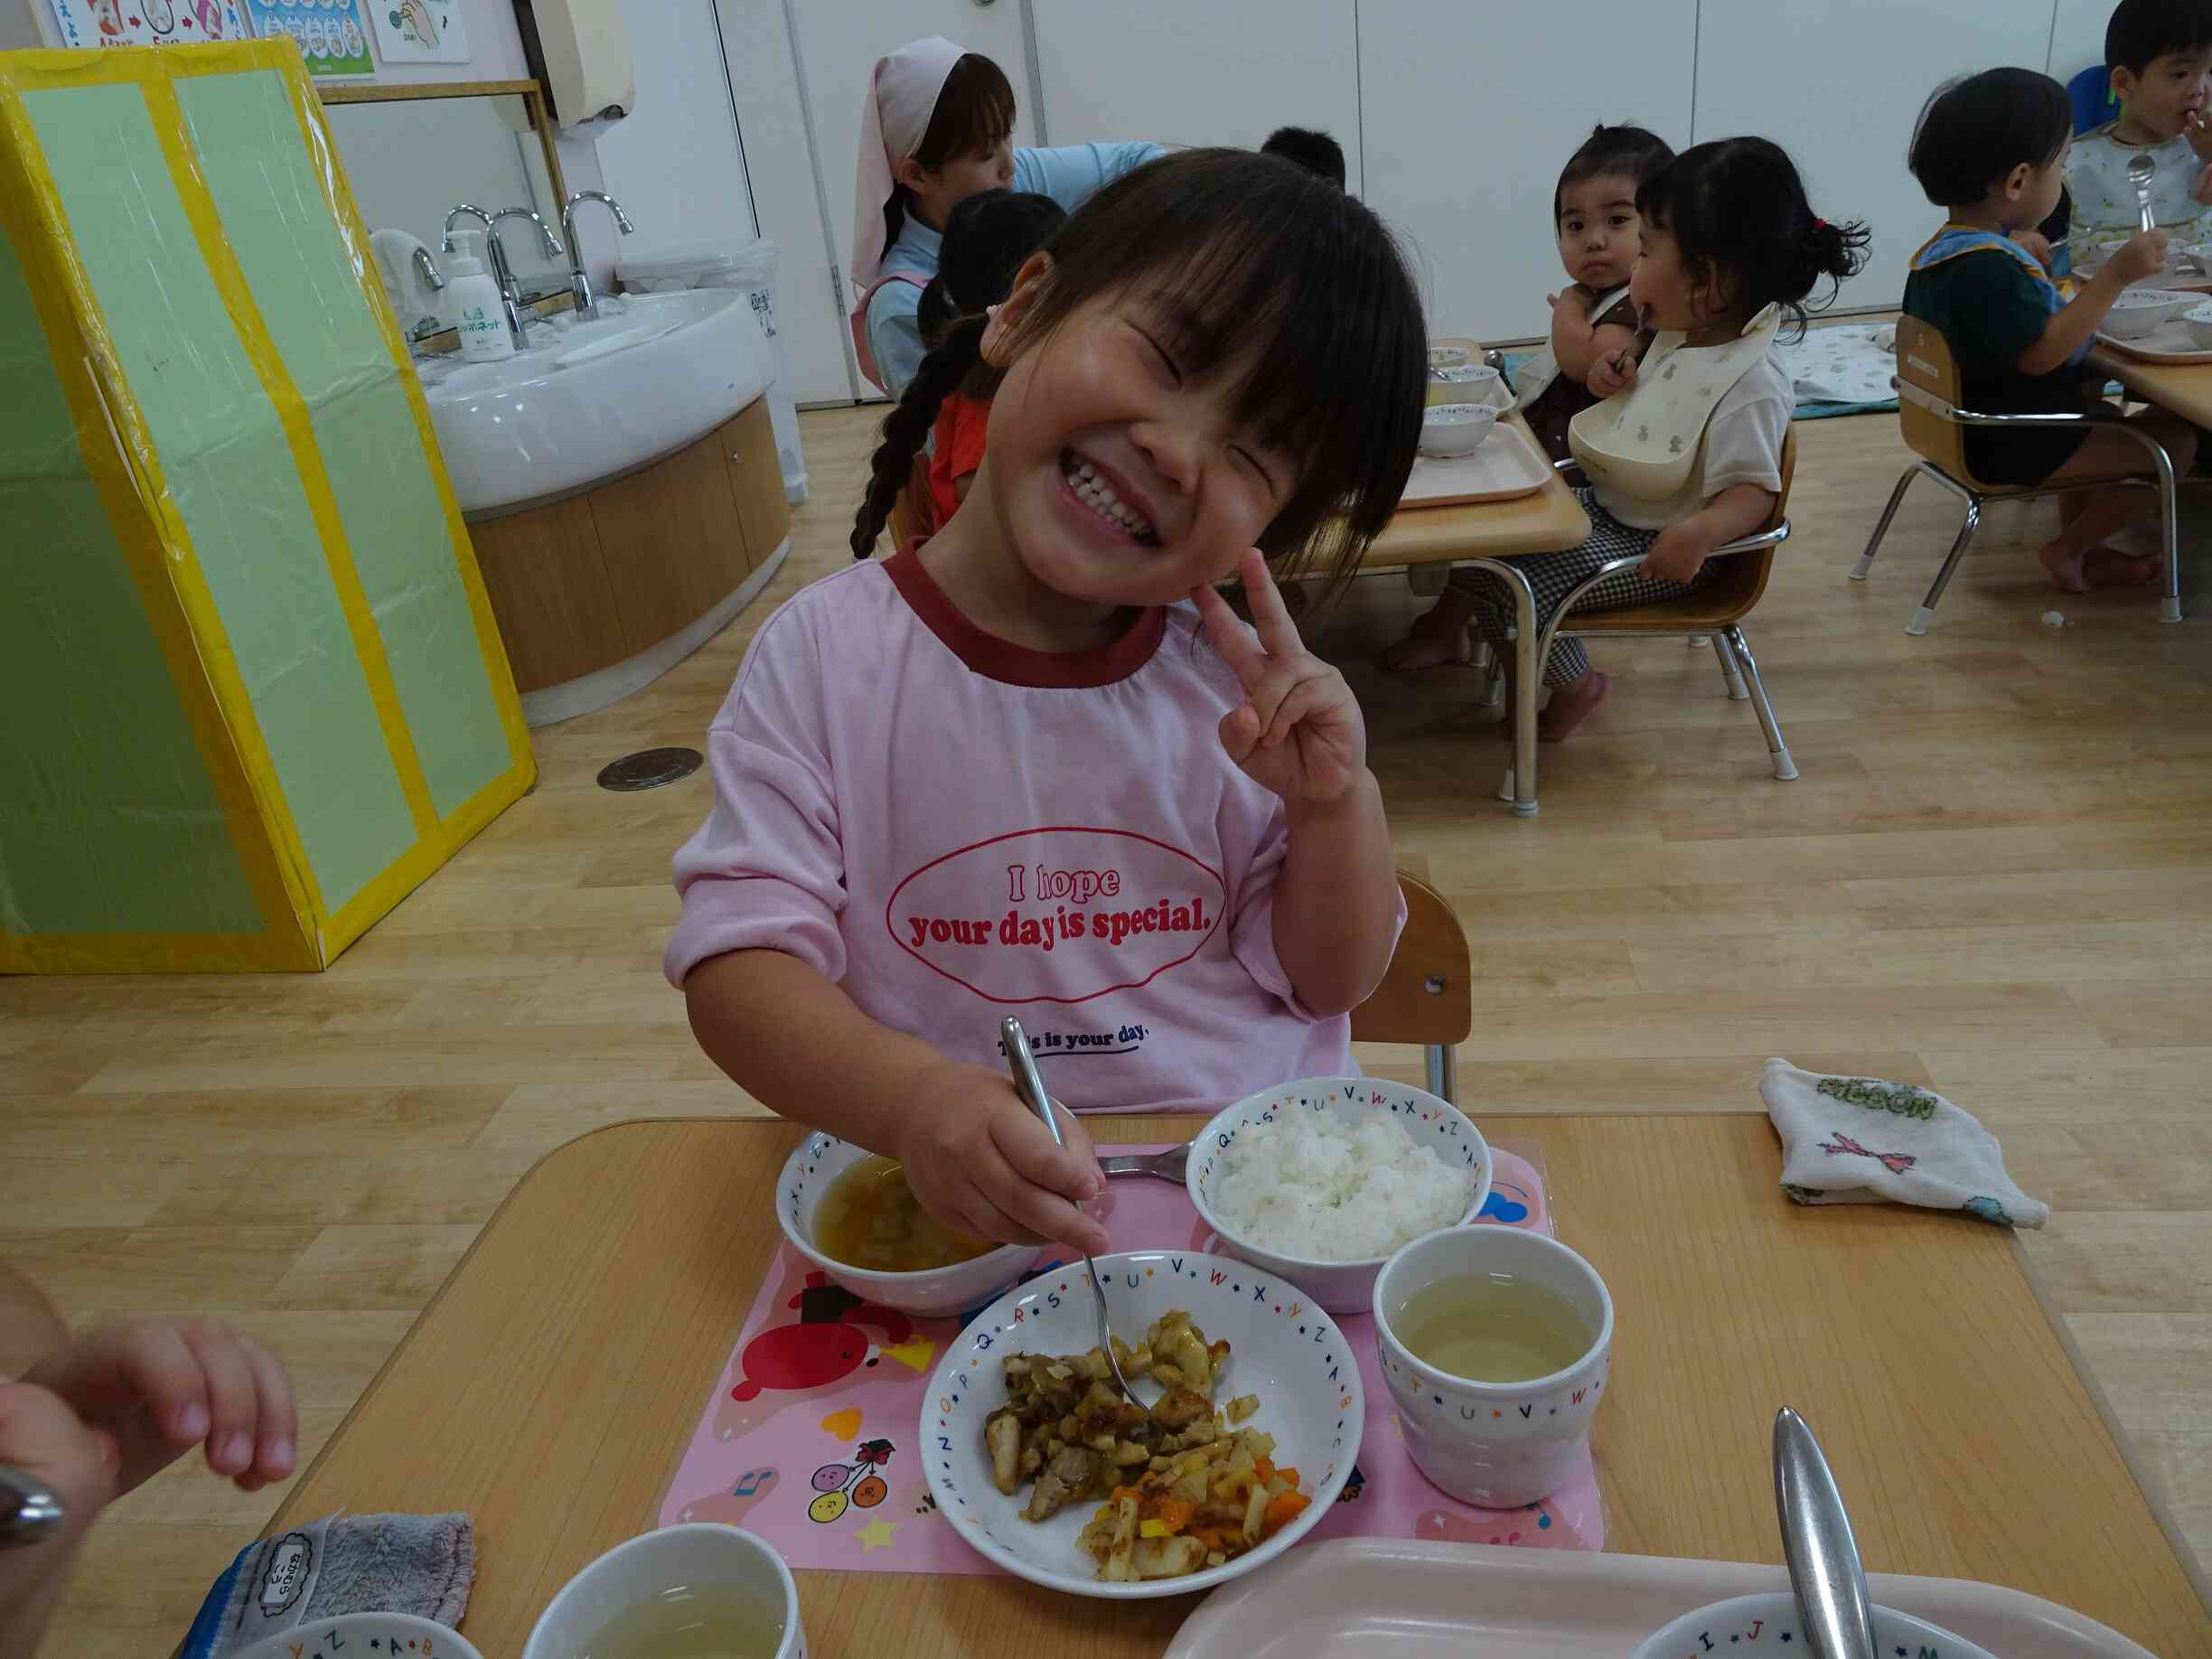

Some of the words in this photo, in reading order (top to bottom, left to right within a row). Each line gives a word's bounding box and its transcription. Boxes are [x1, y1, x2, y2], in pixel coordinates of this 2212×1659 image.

[1008, 865, 1026, 902] I
[1036, 863, 1120, 904] hope
[909, 915, 992, 948] your
[998, 910, 1055, 951] day
[1055, 905, 1085, 940] is
[1092, 897, 1212, 945] special.
[1045, 1031, 1063, 1048] is
[1065, 1032, 1114, 1056] your
[1218, 1133, 1232, 1148] Q
[1262, 1111, 1274, 1123] S
[1314, 1098, 1325, 1112] U
[1344, 1086, 1354, 1100] V
[1404, 1101, 1417, 1114] X
[1449, 1120, 1459, 1136] Z
[977, 1333, 995, 1349] Q
[1014, 1308, 1025, 1323] R
[1047, 1292, 1061, 1308] S
[1127, 1274, 1139, 1289] U
[1172, 1258, 1184, 1273] V
[1210, 1268, 1228, 1287] W
[1253, 1286, 1266, 1302] X
[1314, 1326, 1326, 1343] Z
[1328, 1365, 1338, 1381] A
[1460, 1405, 1475, 1420] U
[1519, 1404, 1532, 1419] V
[1572, 1388, 1587, 1405] W
[323, 1629, 346, 1652] Z
[390, 1637, 404, 1657] A
[421, 1637, 433, 1656] B
[1699, 1630, 1715, 1652] I
[1747, 1620, 1765, 1640] J
